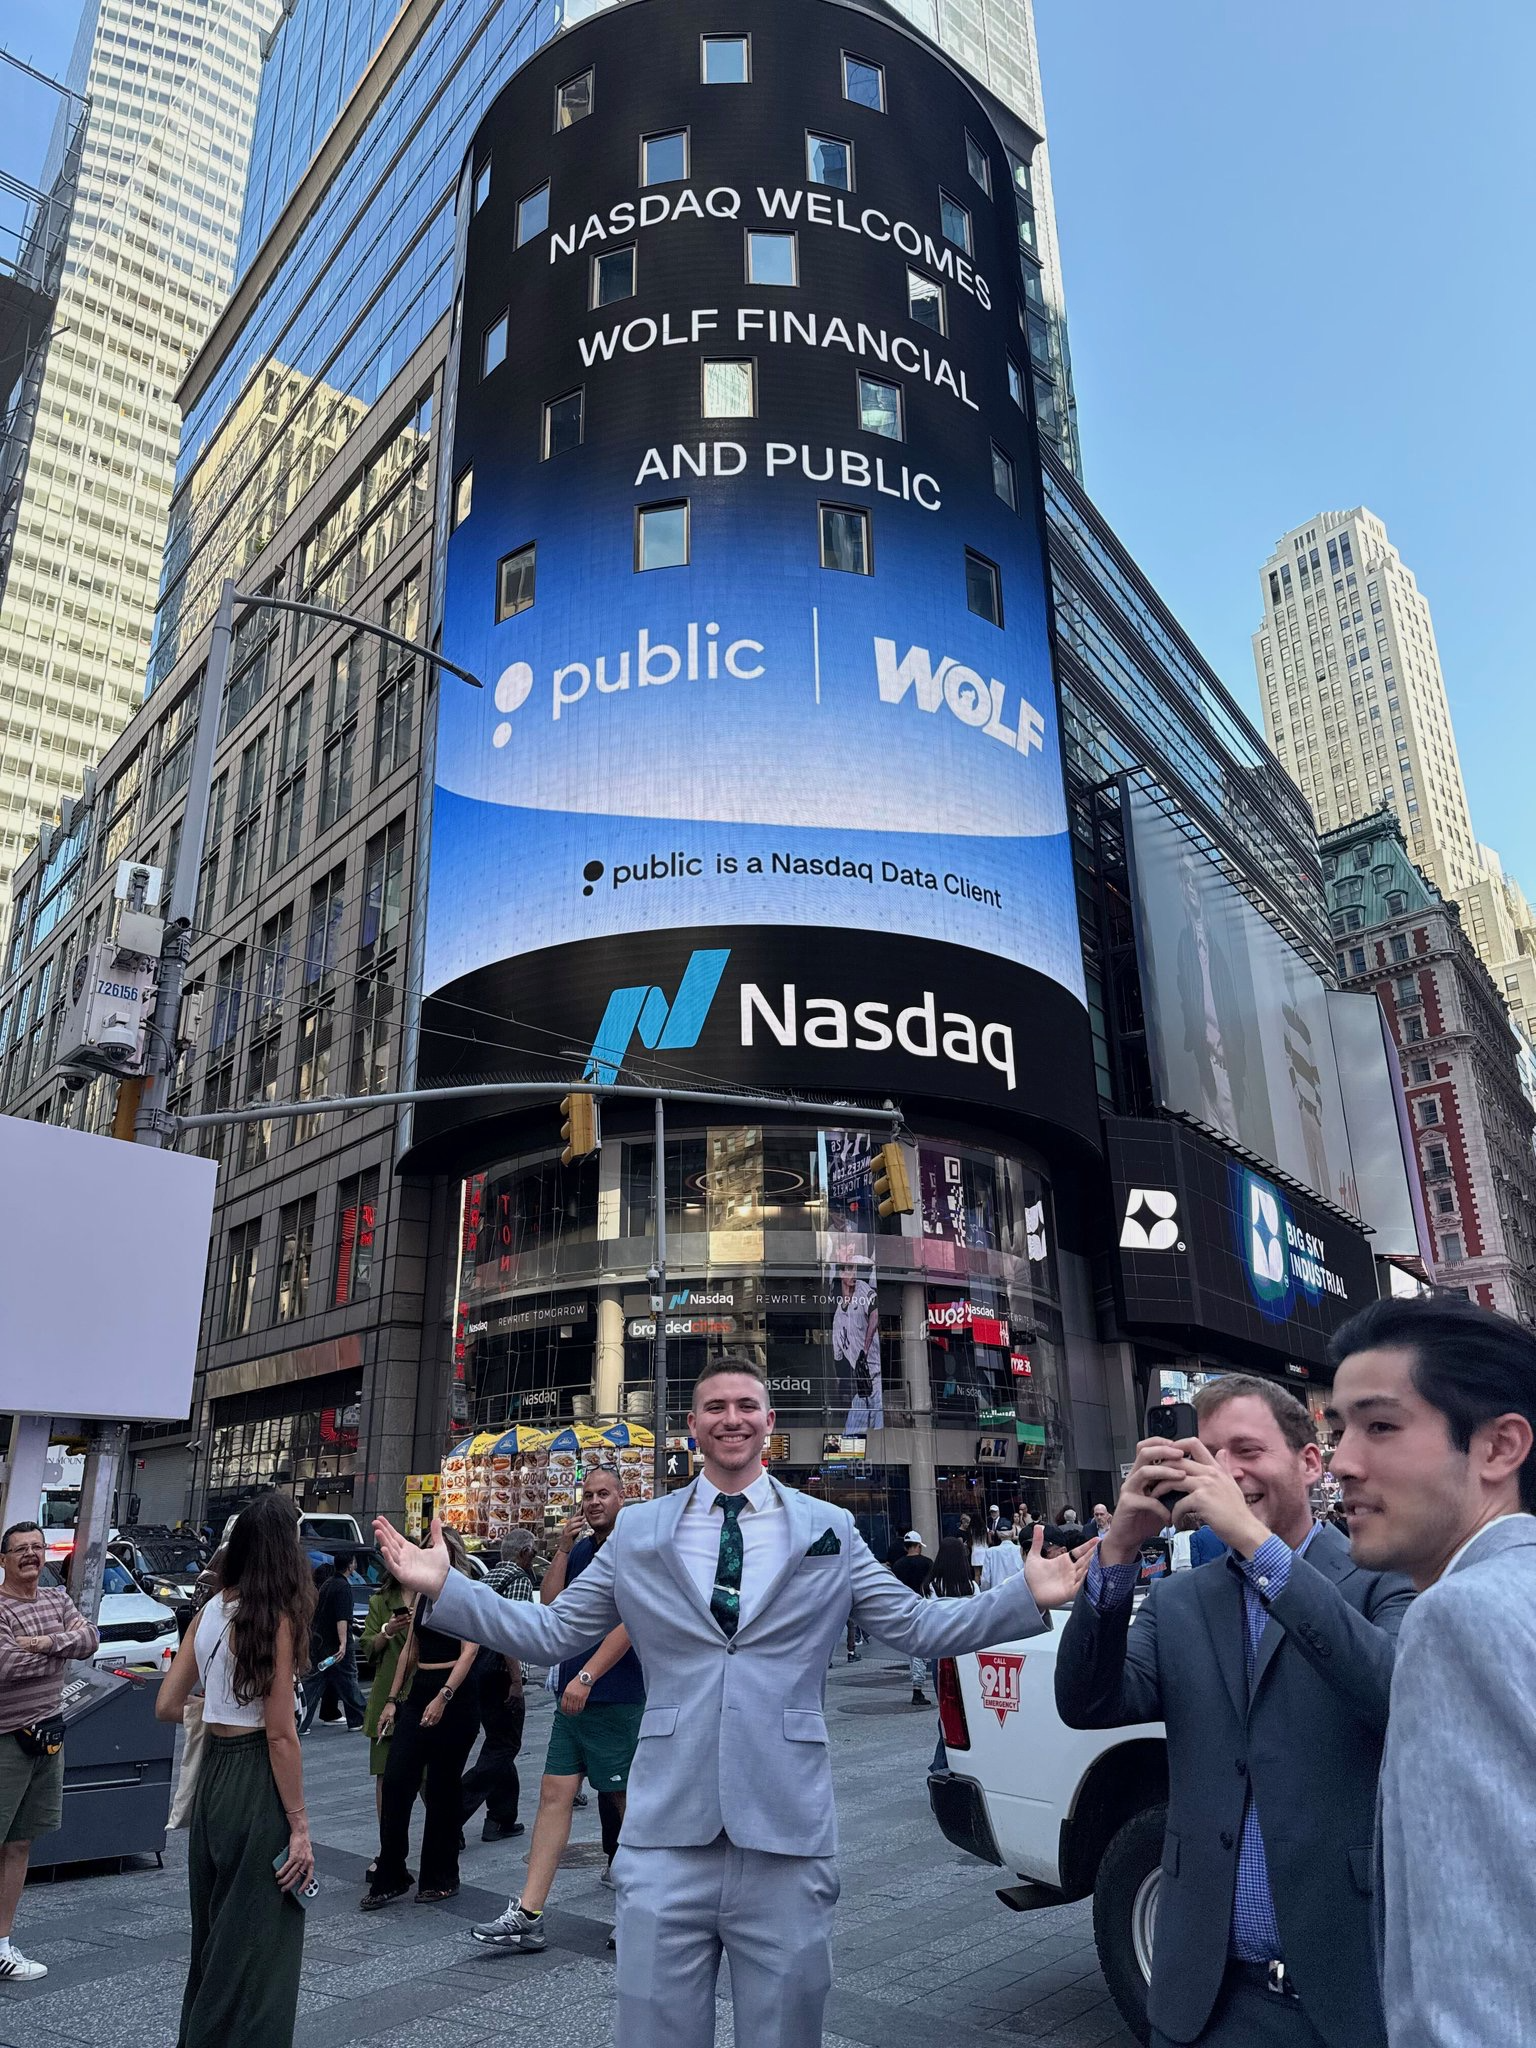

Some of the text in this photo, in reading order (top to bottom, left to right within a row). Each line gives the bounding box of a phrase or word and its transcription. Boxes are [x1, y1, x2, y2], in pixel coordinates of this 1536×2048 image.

[550, 186, 992, 311] NASDAQ WELCOMES
[578, 308, 979, 411] WOLF FINANCIAL
[634, 441, 941, 511] AND PUBLIC
[552, 621, 766, 721] public
[874, 636, 1045, 758] WOLF
[613, 851, 1002, 909] public is a Nasdaq Data Client
[98, 980, 138, 1001] 726156
[740, 983, 1017, 1091] Nasdaq
[1286, 1221, 1325, 1262] BIG SKY
[1290, 1252, 1349, 1300] INDUSTRIAL
[690, 1292, 735, 1307] Nasdaq
[756, 1294, 876, 1307] REWRITE TOMORROW
[964, 1302, 995, 1320] Nasdaq
[468, 1320, 489, 1334] Nasdaq
[498, 1305, 586, 1327] REWRITE TOMORROW
[522, 1389, 557, 1406] Nasdaq
[765, 1375, 811, 1395] asdaq
[985, 1700, 1016, 1708] EMERGENCY
